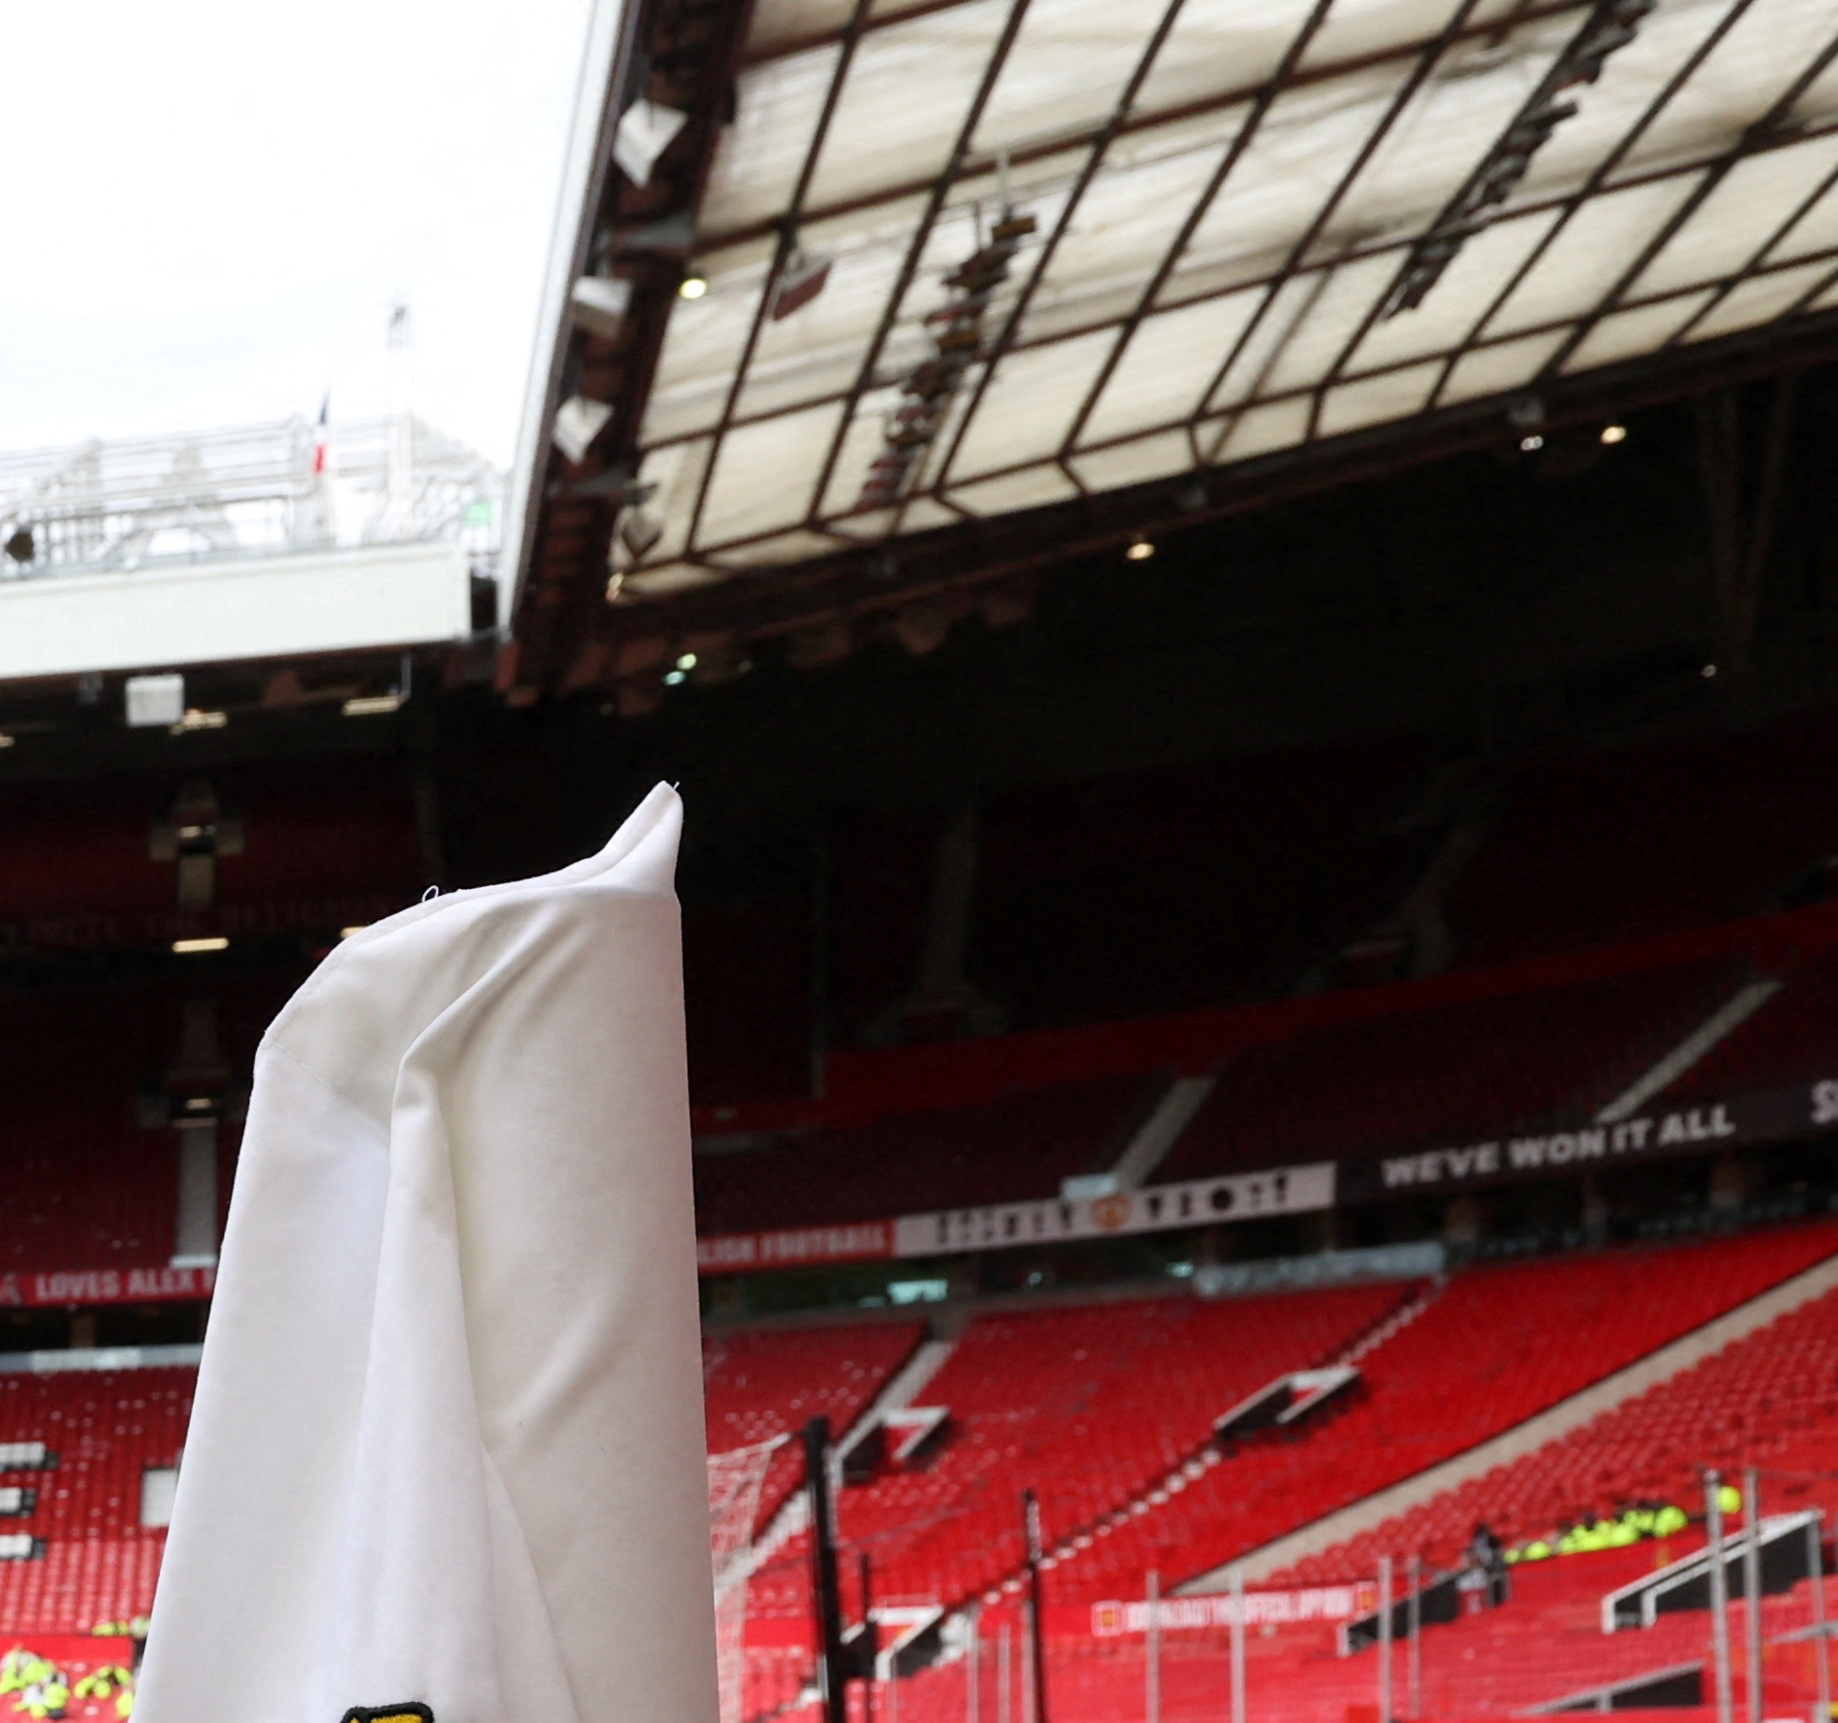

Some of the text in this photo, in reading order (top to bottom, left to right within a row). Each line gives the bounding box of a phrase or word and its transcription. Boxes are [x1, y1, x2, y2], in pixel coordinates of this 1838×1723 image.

[1509, 1127, 1604, 1169] WON
[1612, 1117, 1655, 1153] IT
[1658, 1103, 1735, 1147] ALL
[36, 1270, 120, 1299] LOVES
[129, 1266, 195, 1295] ALEX
